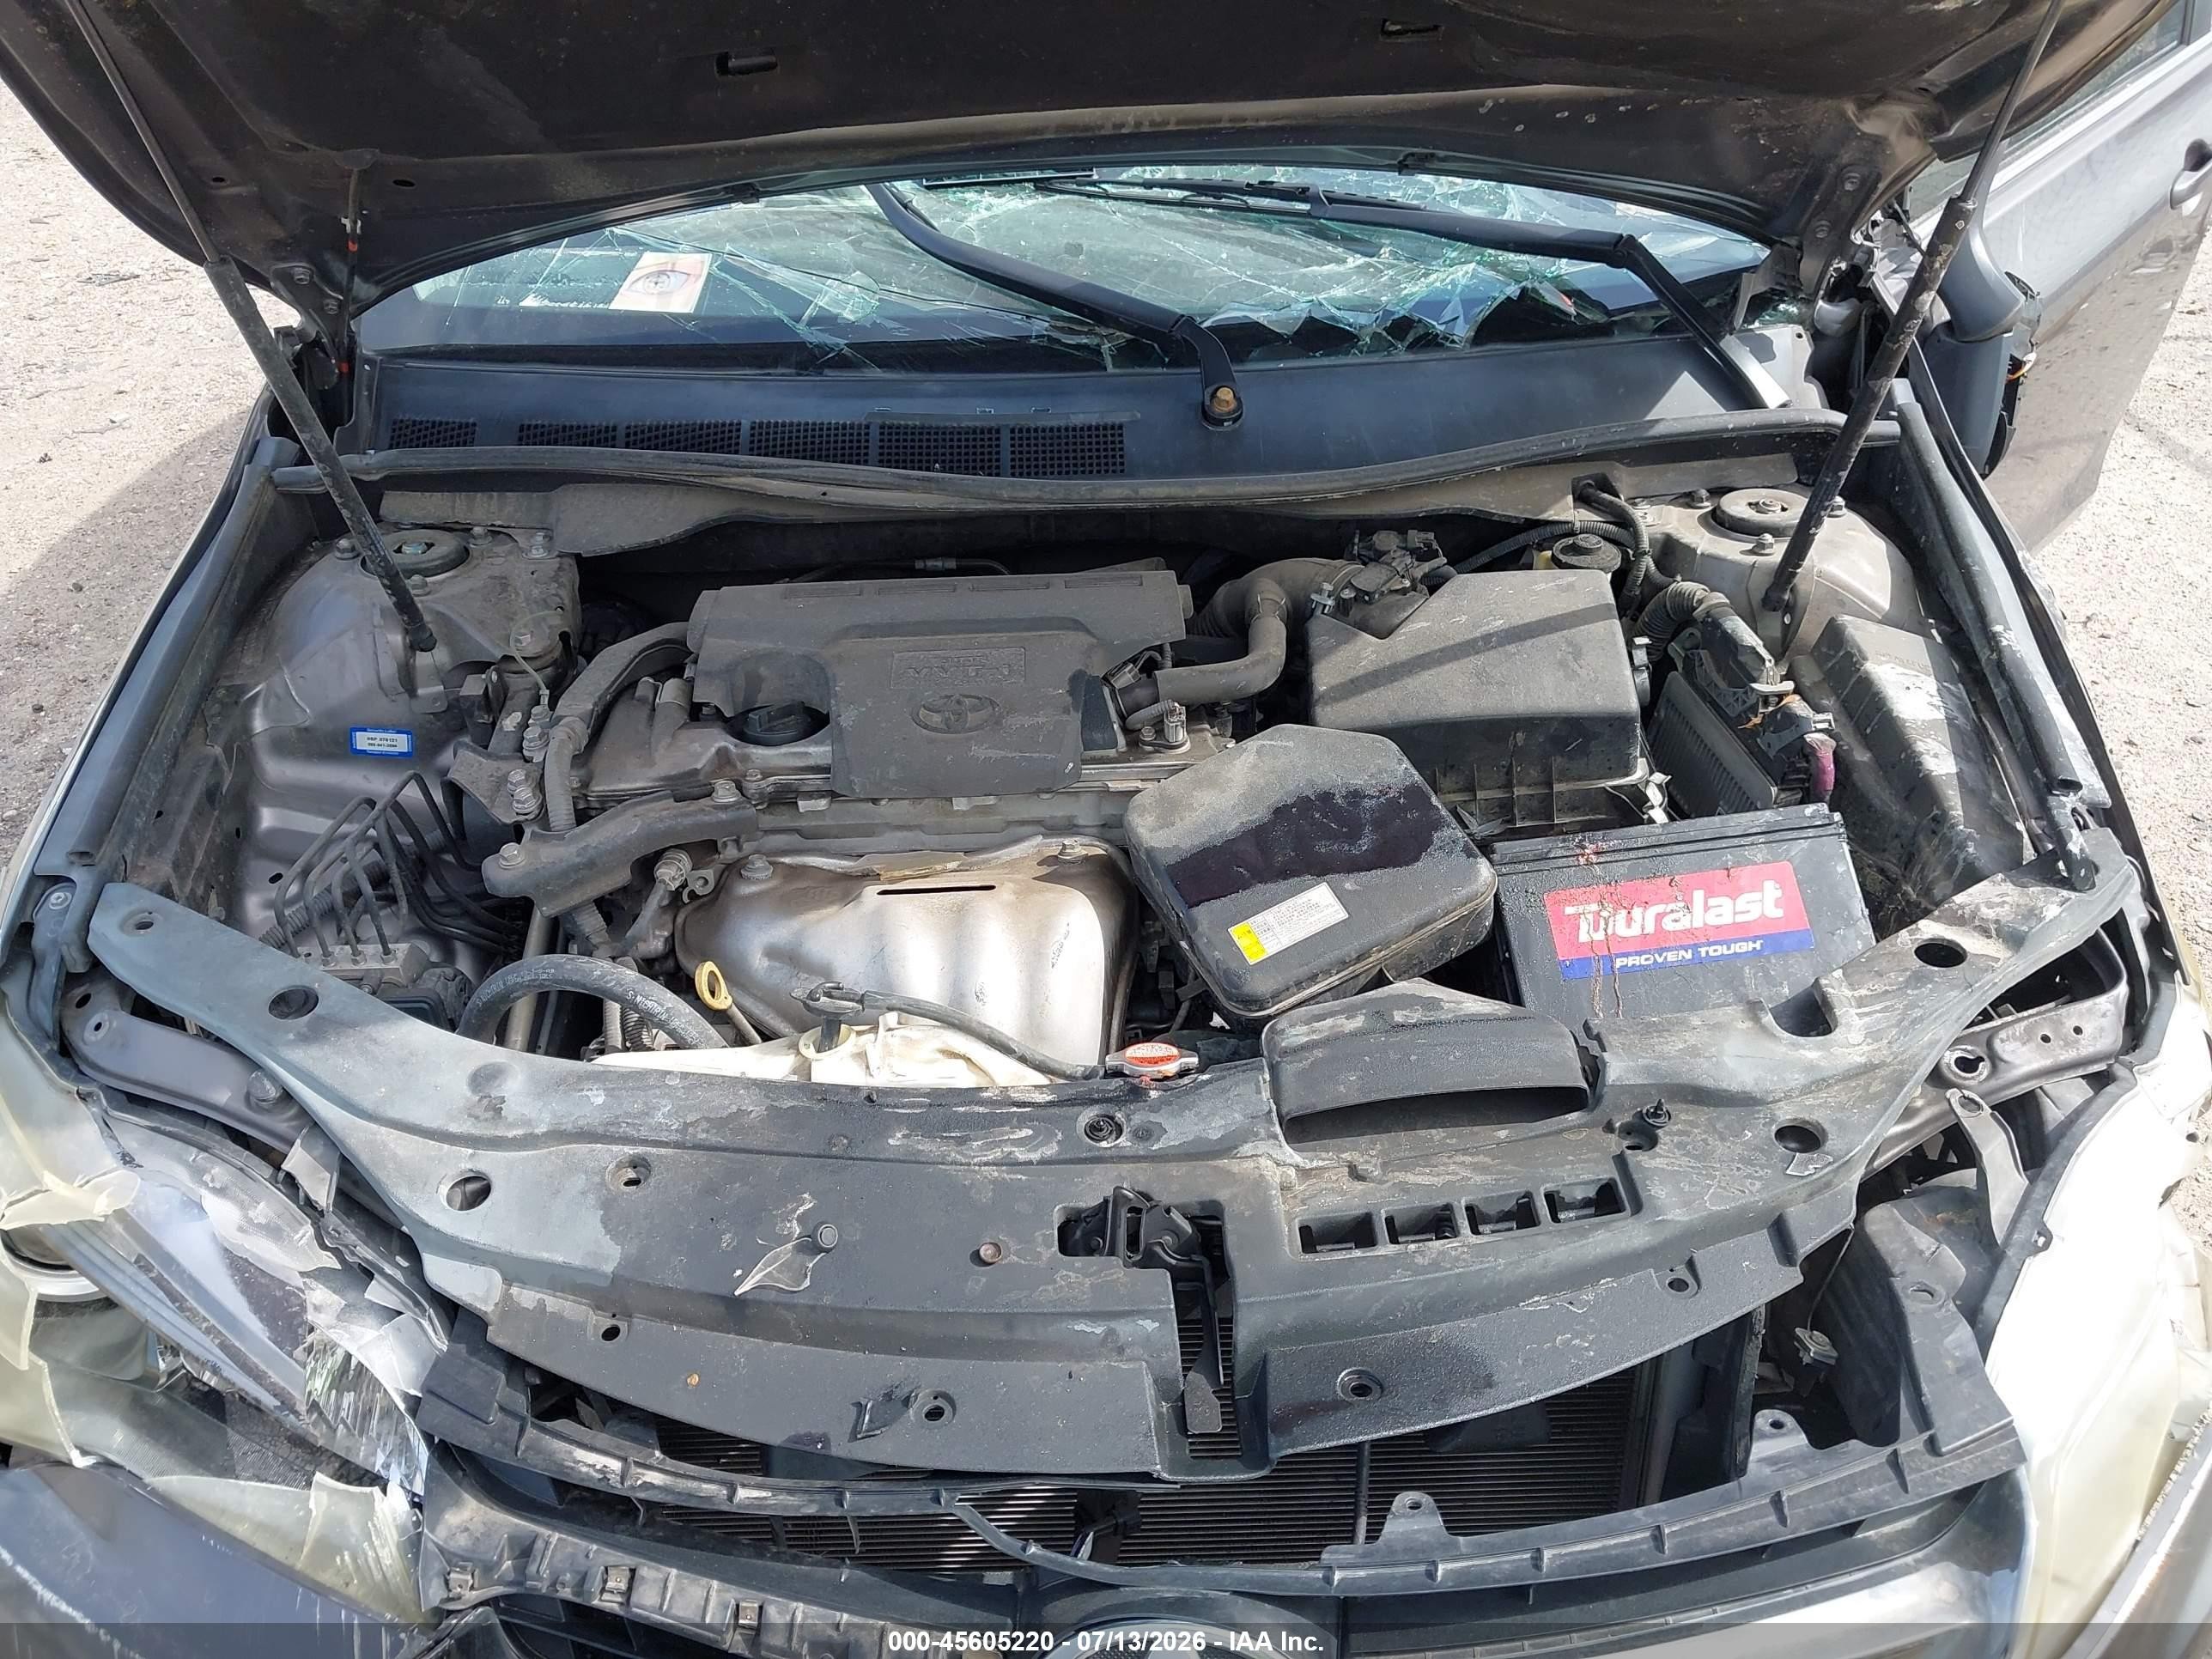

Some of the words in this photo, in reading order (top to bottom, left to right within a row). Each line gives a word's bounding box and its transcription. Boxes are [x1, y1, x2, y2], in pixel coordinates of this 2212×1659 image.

[1564, 878, 1784, 943] Duralast
[1615, 949, 1692, 969] PROVEN
[1699, 940, 1763, 958] TOUGH
